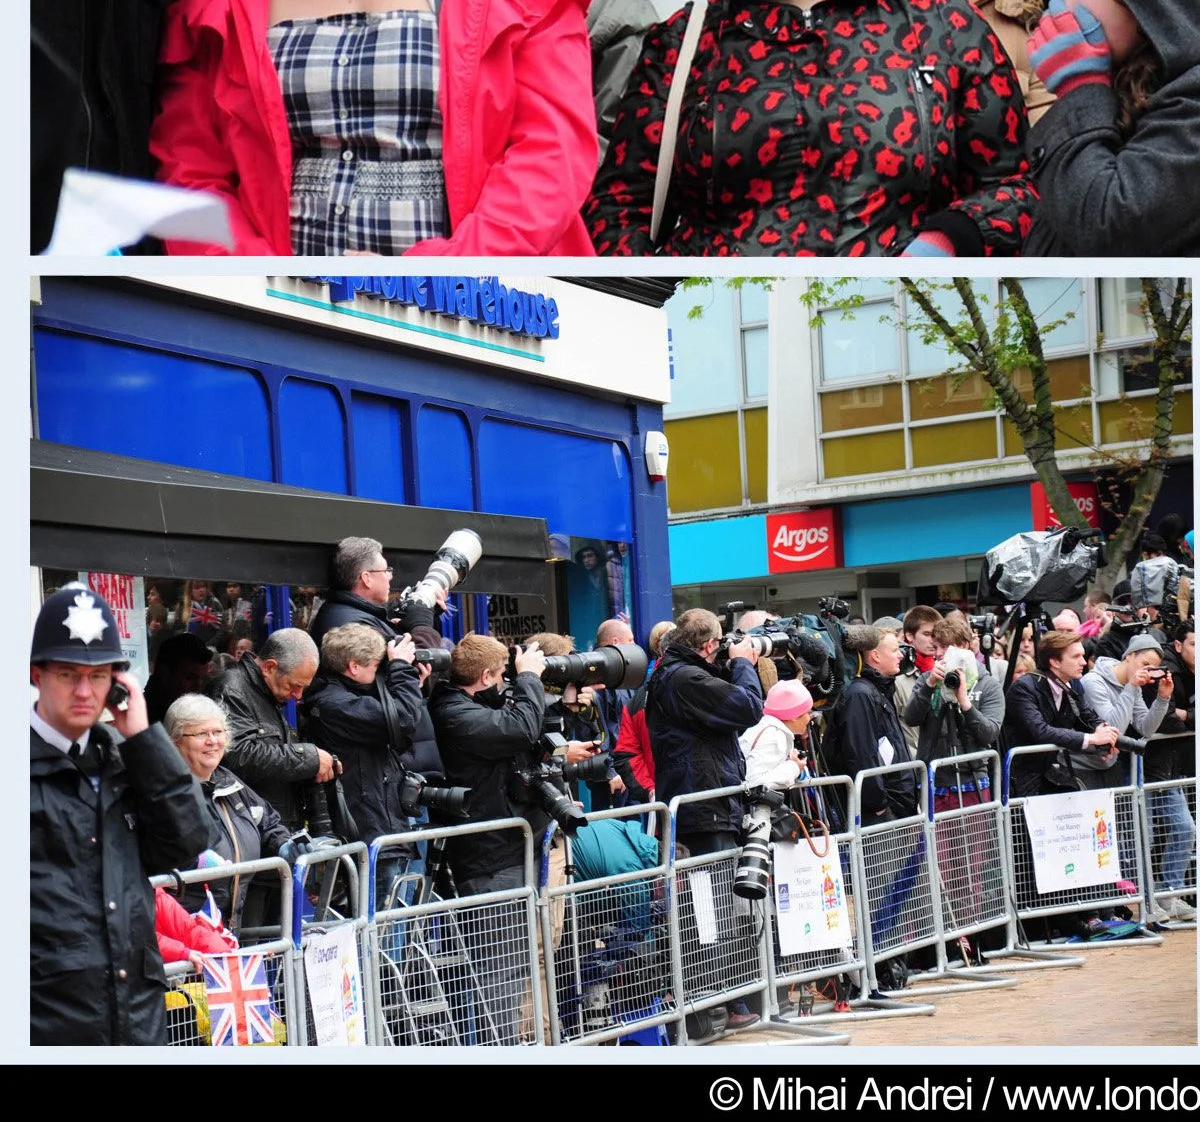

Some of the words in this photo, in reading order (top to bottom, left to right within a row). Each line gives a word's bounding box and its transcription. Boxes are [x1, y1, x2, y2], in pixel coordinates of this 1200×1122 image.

[772, 525, 829, 553] Argos
[488, 593, 519, 617] BIG
[488, 614, 546, 636] PROMISES
